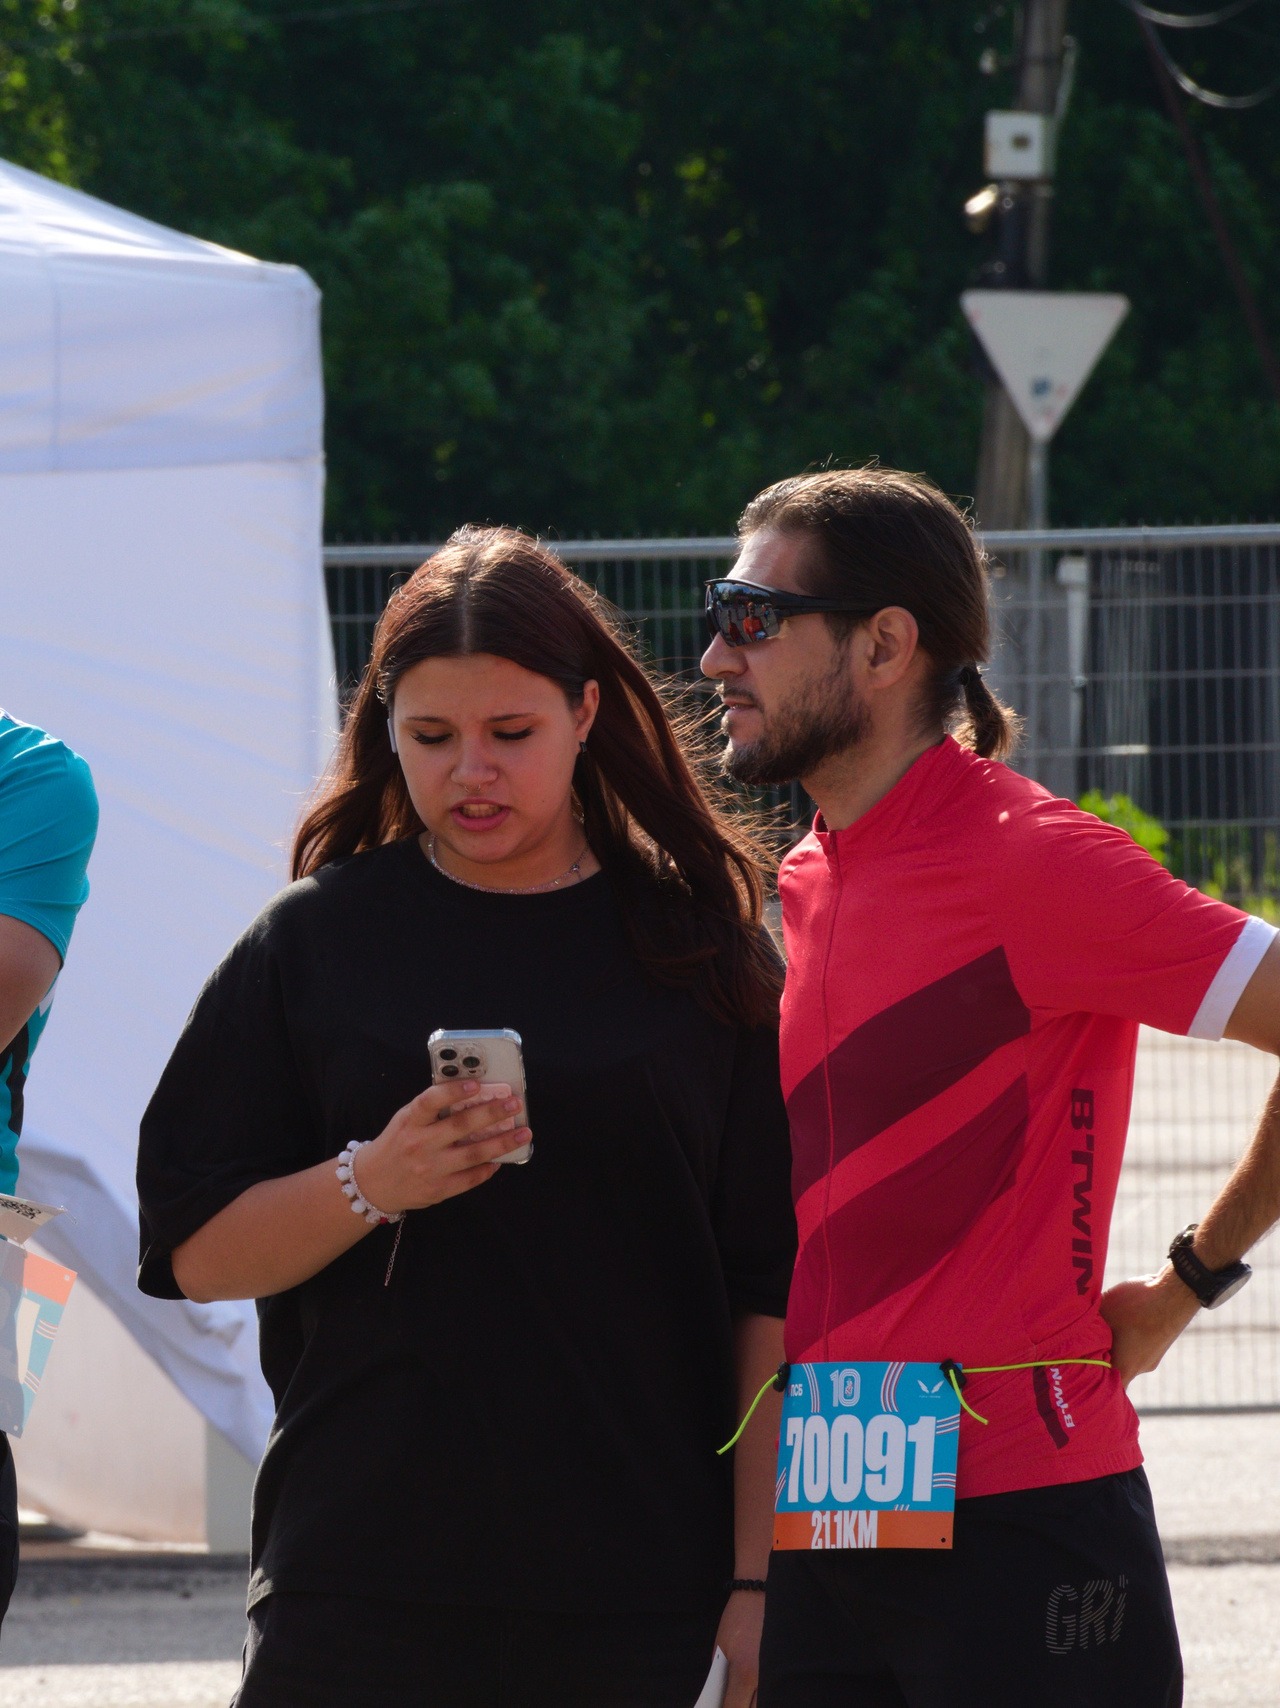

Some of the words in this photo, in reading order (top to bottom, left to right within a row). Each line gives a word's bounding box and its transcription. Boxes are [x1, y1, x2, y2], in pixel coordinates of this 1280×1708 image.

[830, 1368, 861, 1407] 10
[786, 1414, 937, 1503] 70091
[810, 1510, 878, 1550] 21.1KM
